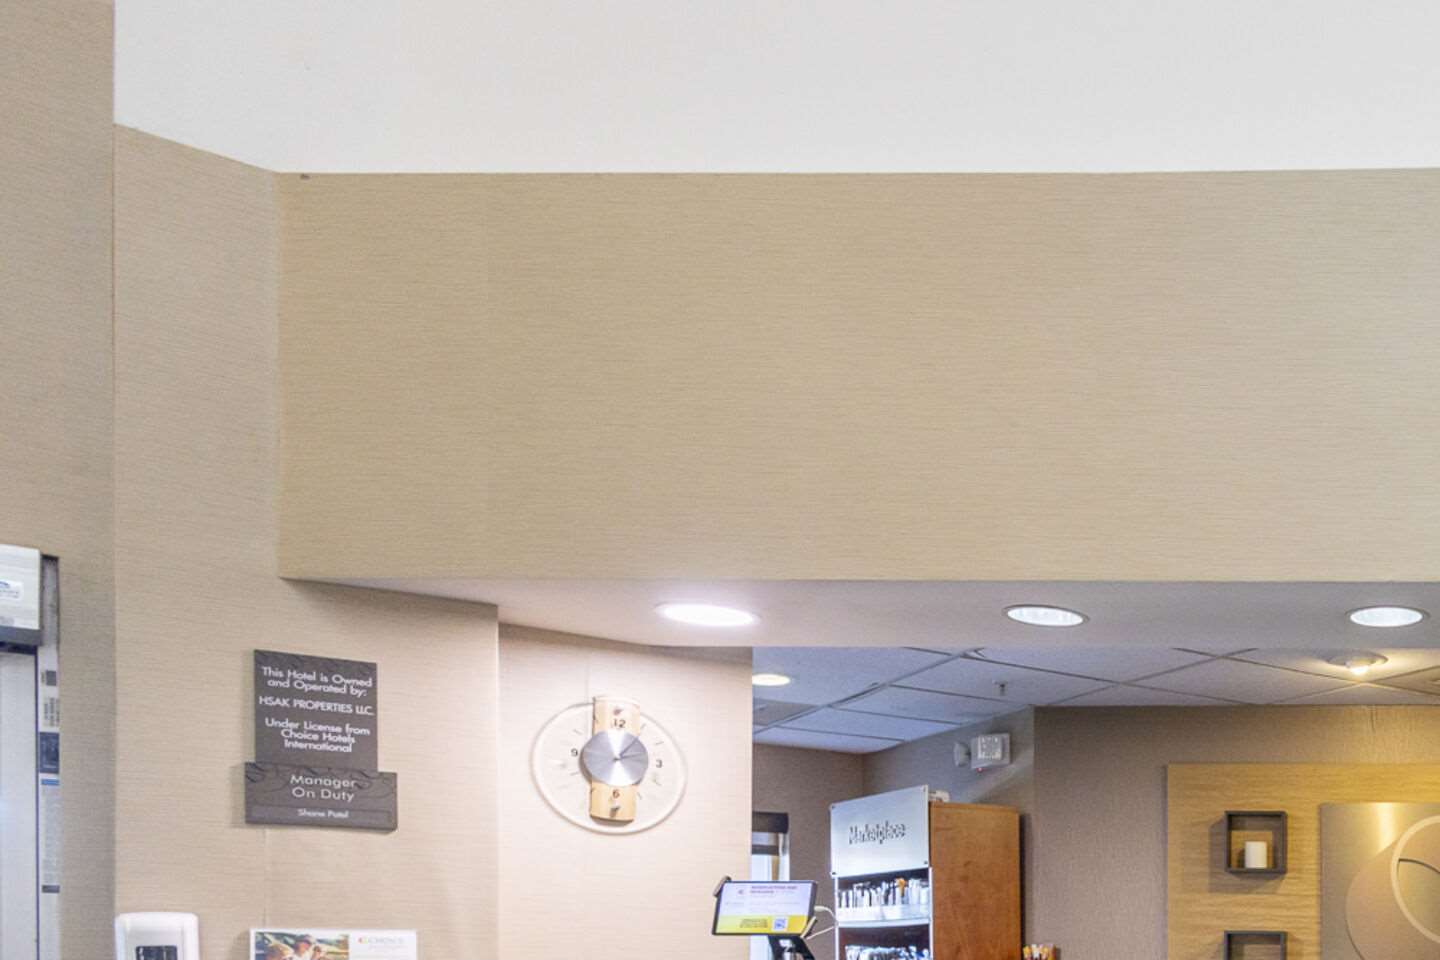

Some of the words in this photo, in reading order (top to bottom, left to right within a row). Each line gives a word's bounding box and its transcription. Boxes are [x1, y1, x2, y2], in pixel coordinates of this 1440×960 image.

[262, 666, 283, 678] This
[287, 669, 316, 681] Hotel
[320, 672, 328, 682] is
[331, 673, 373, 688] Owned
[267, 679, 290, 688] and
[293, 680, 347, 694] Operated
[350, 686, 367, 698] by:
[259, 695, 290, 708] HSAK
[293, 698, 353, 714] PROPERTIES
[264, 717, 300, 729] Under
[303, 720, 342, 733] License
[345, 723, 371, 736] from
[612, 718, 626, 729] 12
[280, 728, 319, 741] Choice
[322, 731, 355, 744] Hotels
[284, 738, 353, 753] International
[570, 748, 578, 757] 9
[655, 759, 663, 768] 3
[290, 774, 357, 789] Manager
[291, 786, 315, 799] On
[320, 788, 354, 802] Duty
[612, 788, 620, 799] 6
[848, 819, 906, 845] Marketplace
